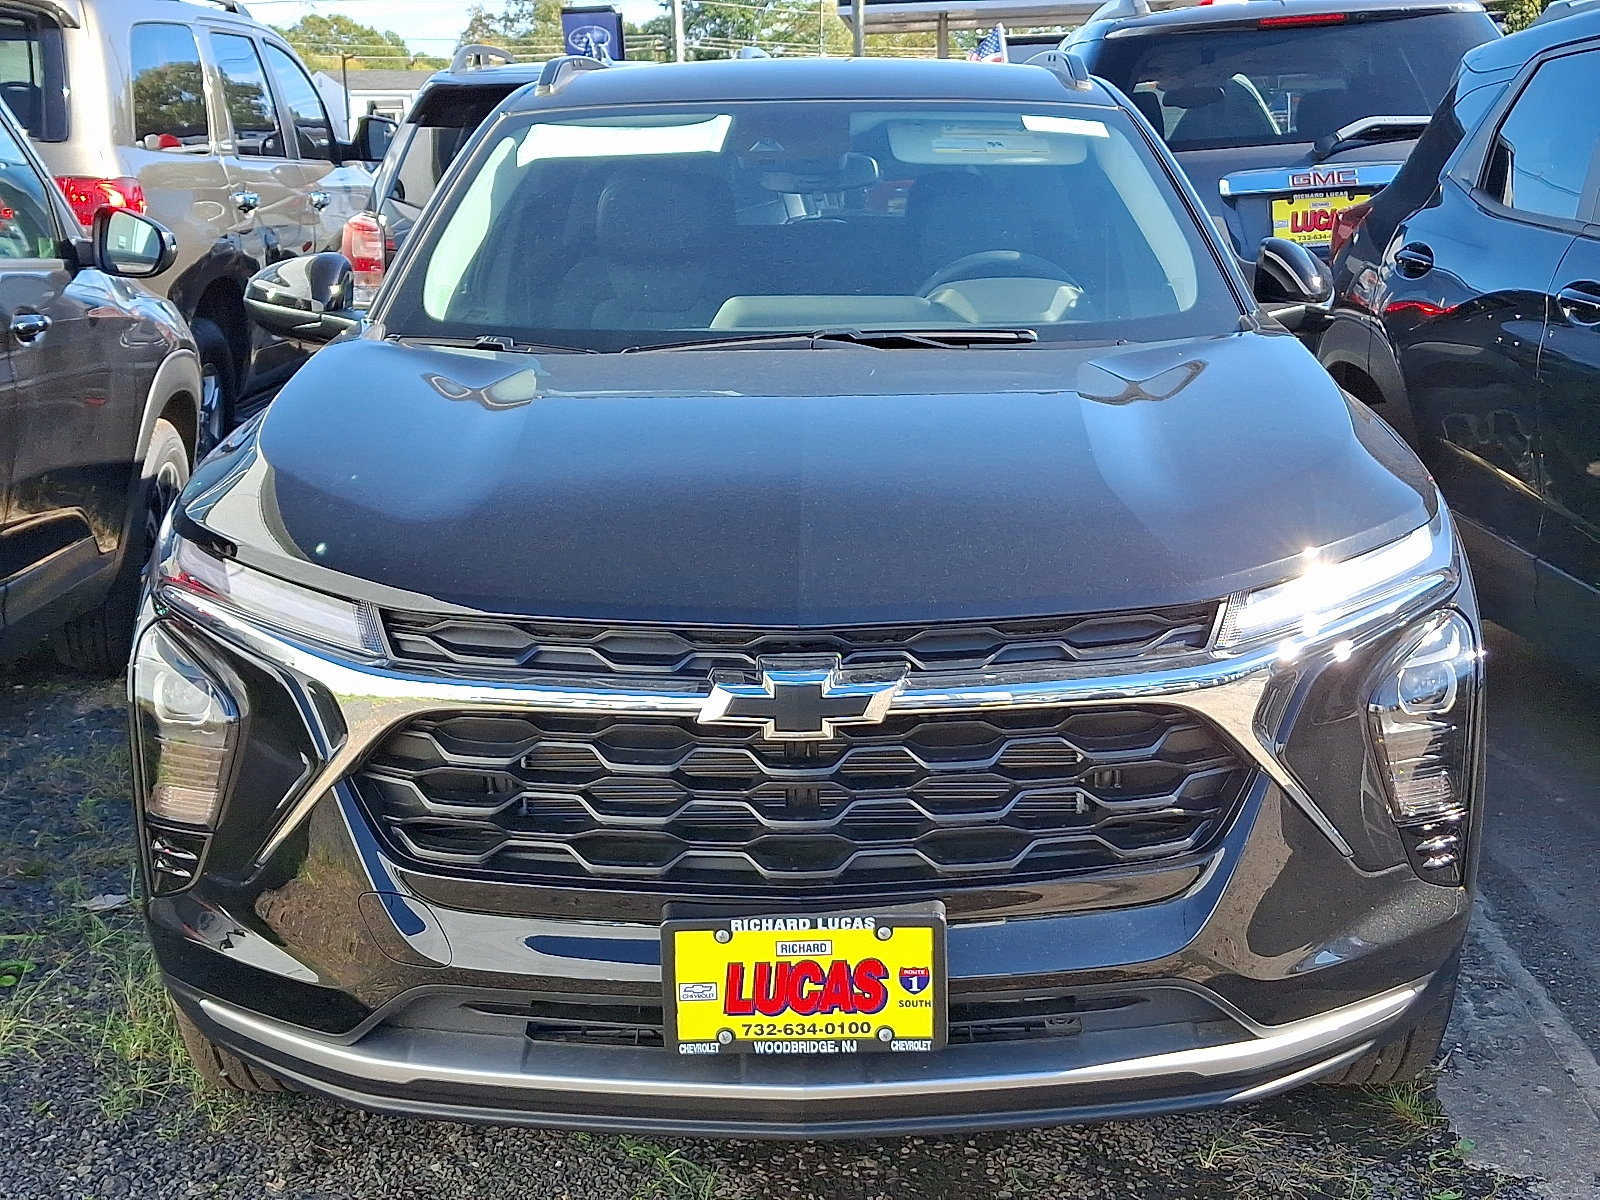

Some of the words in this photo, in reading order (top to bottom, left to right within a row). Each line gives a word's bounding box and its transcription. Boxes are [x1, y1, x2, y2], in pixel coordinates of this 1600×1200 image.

[1289, 168, 1359, 188] GMC
[1291, 209, 1337, 233] LUCA
[731, 919, 811, 931] RICHARD
[817, 917, 876, 930] LUCAS
[780, 943, 827, 954] RICHARD
[724, 958, 889, 1016] LUCAS
[908, 975, 921, 992] 1
[898, 1000, 932, 1008] SOUTH
[741, 1022, 871, 1036] 732-634-0100
[678, 1042, 721, 1054] CHEVROLET
[842, 1041, 857, 1052] NJ
[890, 1040, 932, 1051] CHEVROLET
